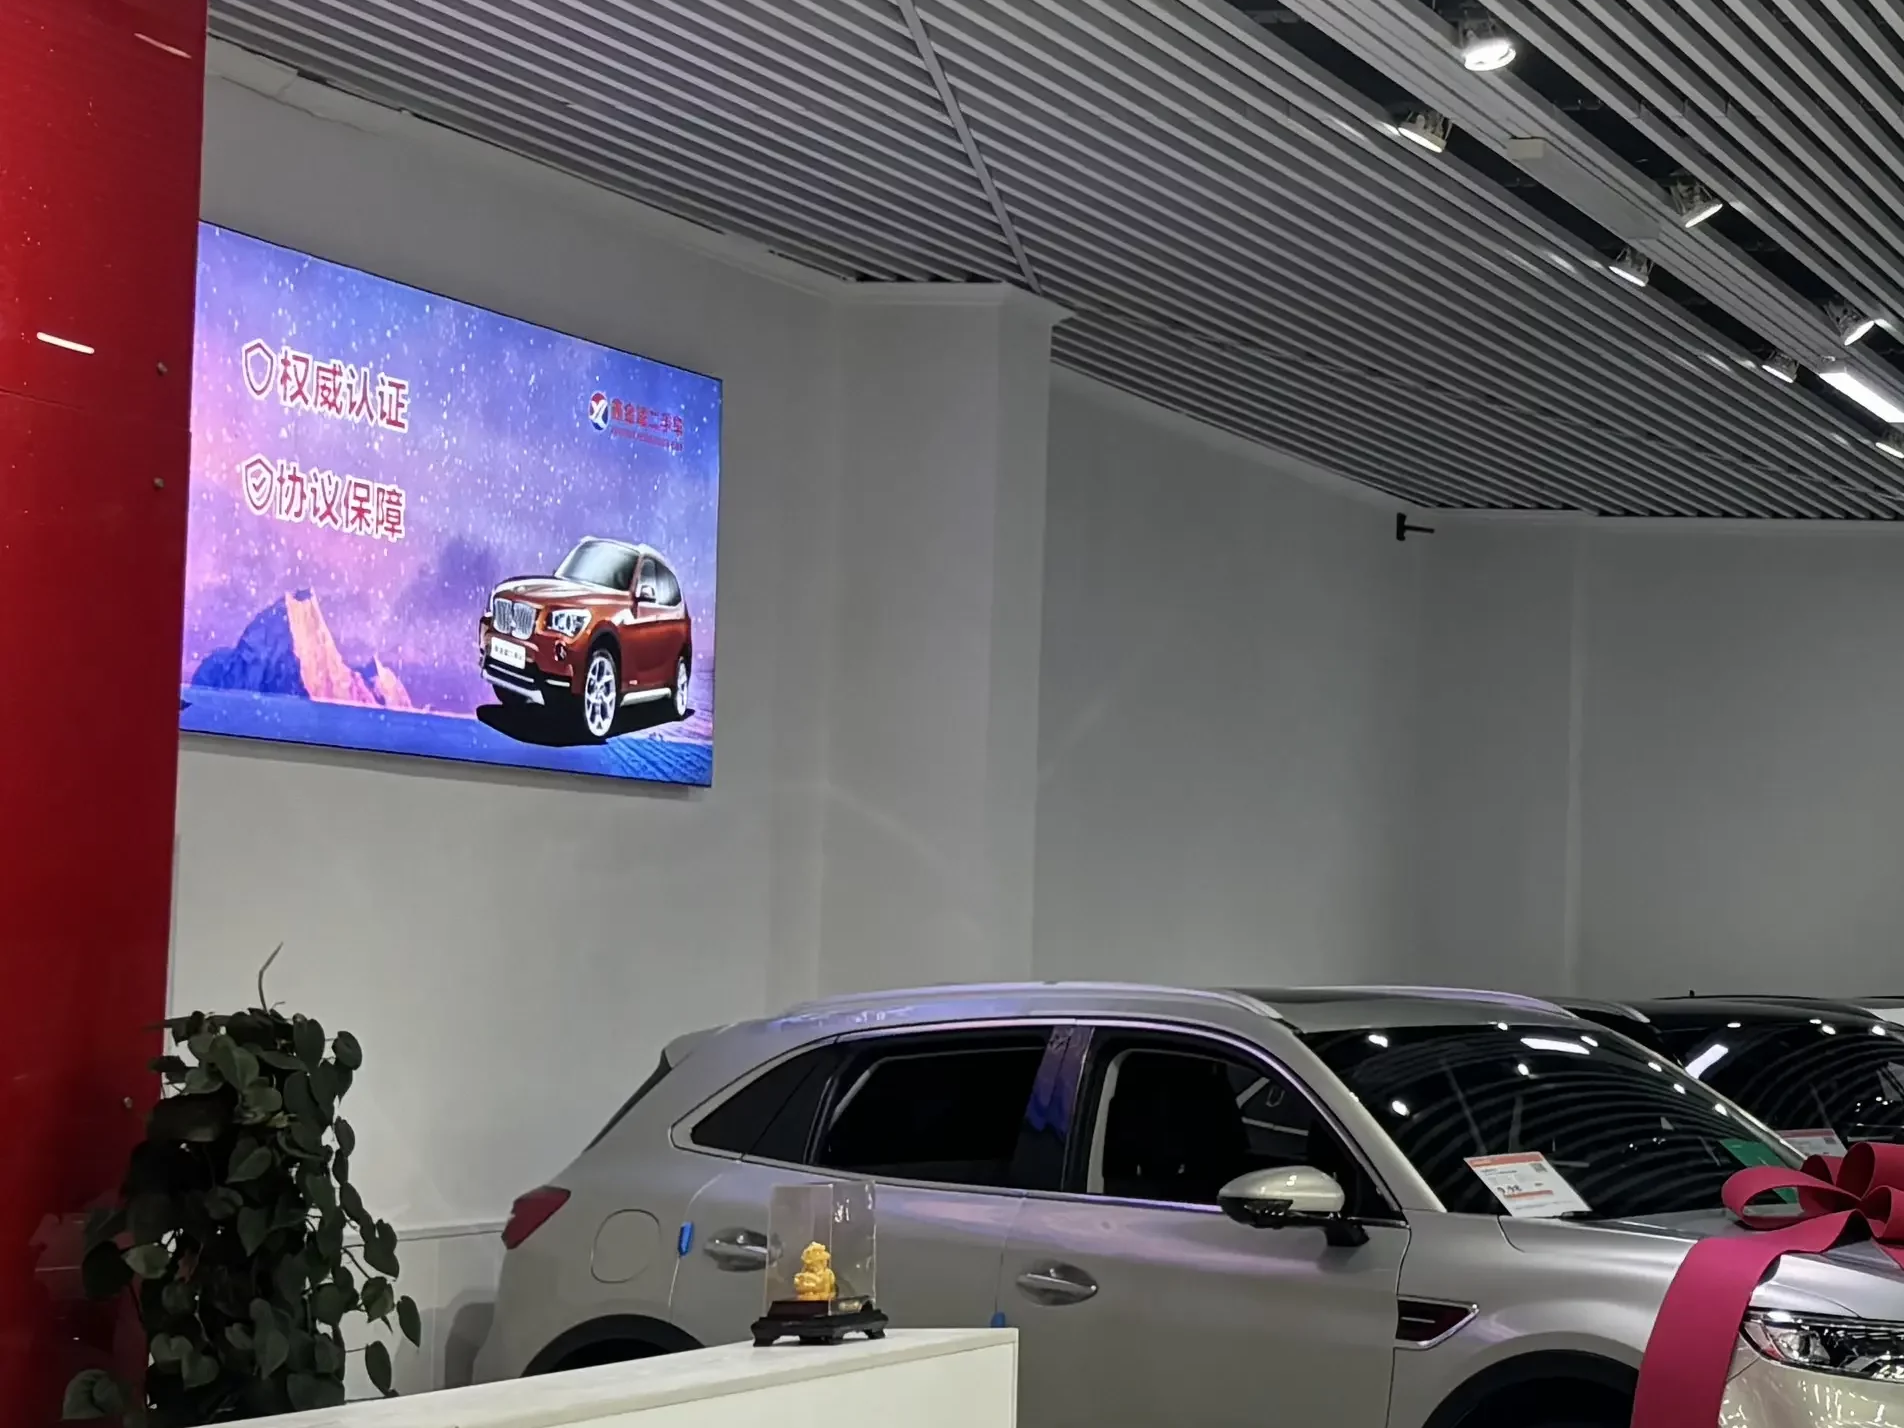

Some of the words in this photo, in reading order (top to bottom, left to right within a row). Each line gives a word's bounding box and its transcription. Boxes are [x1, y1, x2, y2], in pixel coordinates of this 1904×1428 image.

[278, 347, 410, 432] 权威认证
[276, 459, 407, 541] 协议保障
